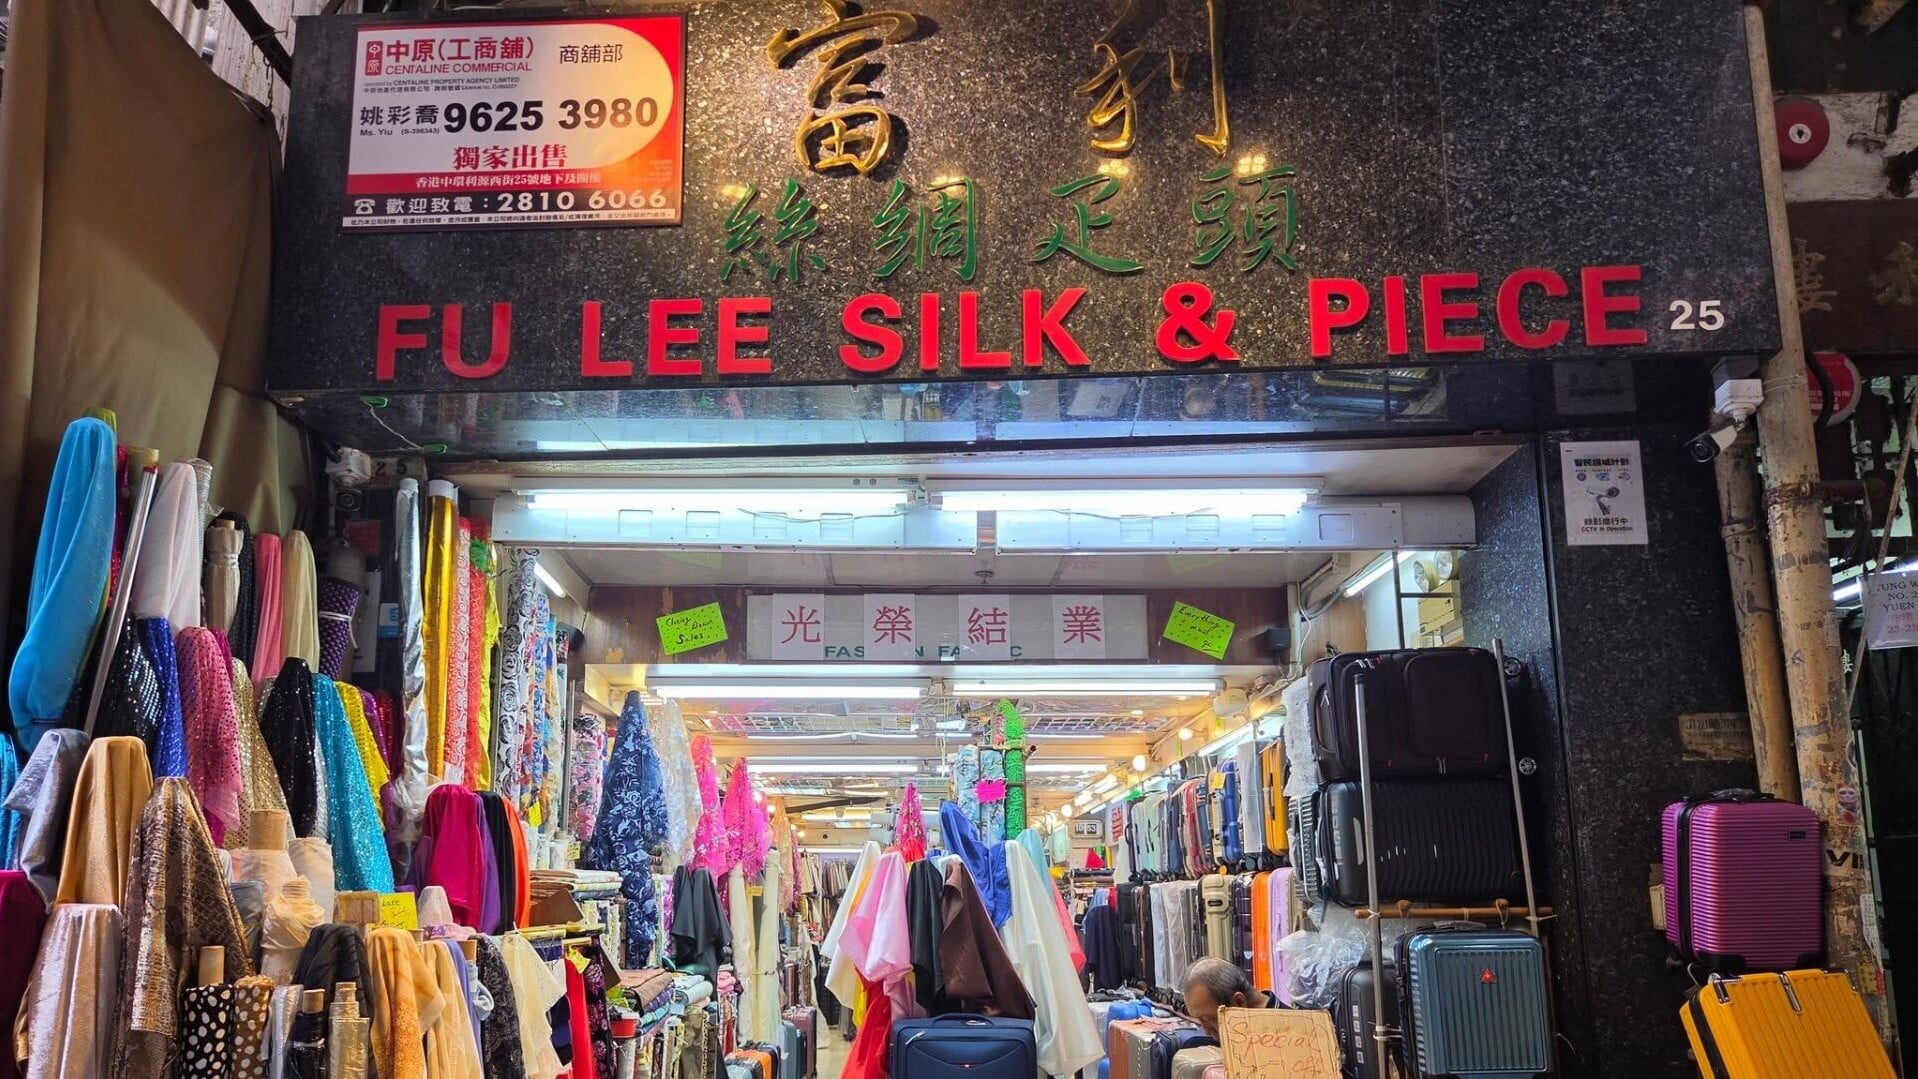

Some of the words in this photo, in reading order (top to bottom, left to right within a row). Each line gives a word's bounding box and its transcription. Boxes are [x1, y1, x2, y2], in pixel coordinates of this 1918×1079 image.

[385, 64, 450, 75] CENTALINE
[452, 62, 532, 73] COMMERCIAL
[360, 105, 439, 125] 姚彩喬
[443, 100, 544, 133] 9625
[558, 97, 659, 130] 3980
[378, 128, 393, 136] Yiu
[454, 144, 567, 170] 獨家出售
[497, 191, 575, 212] 2810
[588, 188, 667, 209] 6066
[375, 301, 511, 381] FU
[581, 297, 772, 377] LEE
[838, 288, 1090, 373] SILK
[1155, 280, 1240, 362] &
[1308, 264, 1648, 358] PIECE
[1668, 299, 1725, 331] 25
[1883, 602, 1915, 612] YUEN
[781, 605, 1102, 646] 光榮結業
